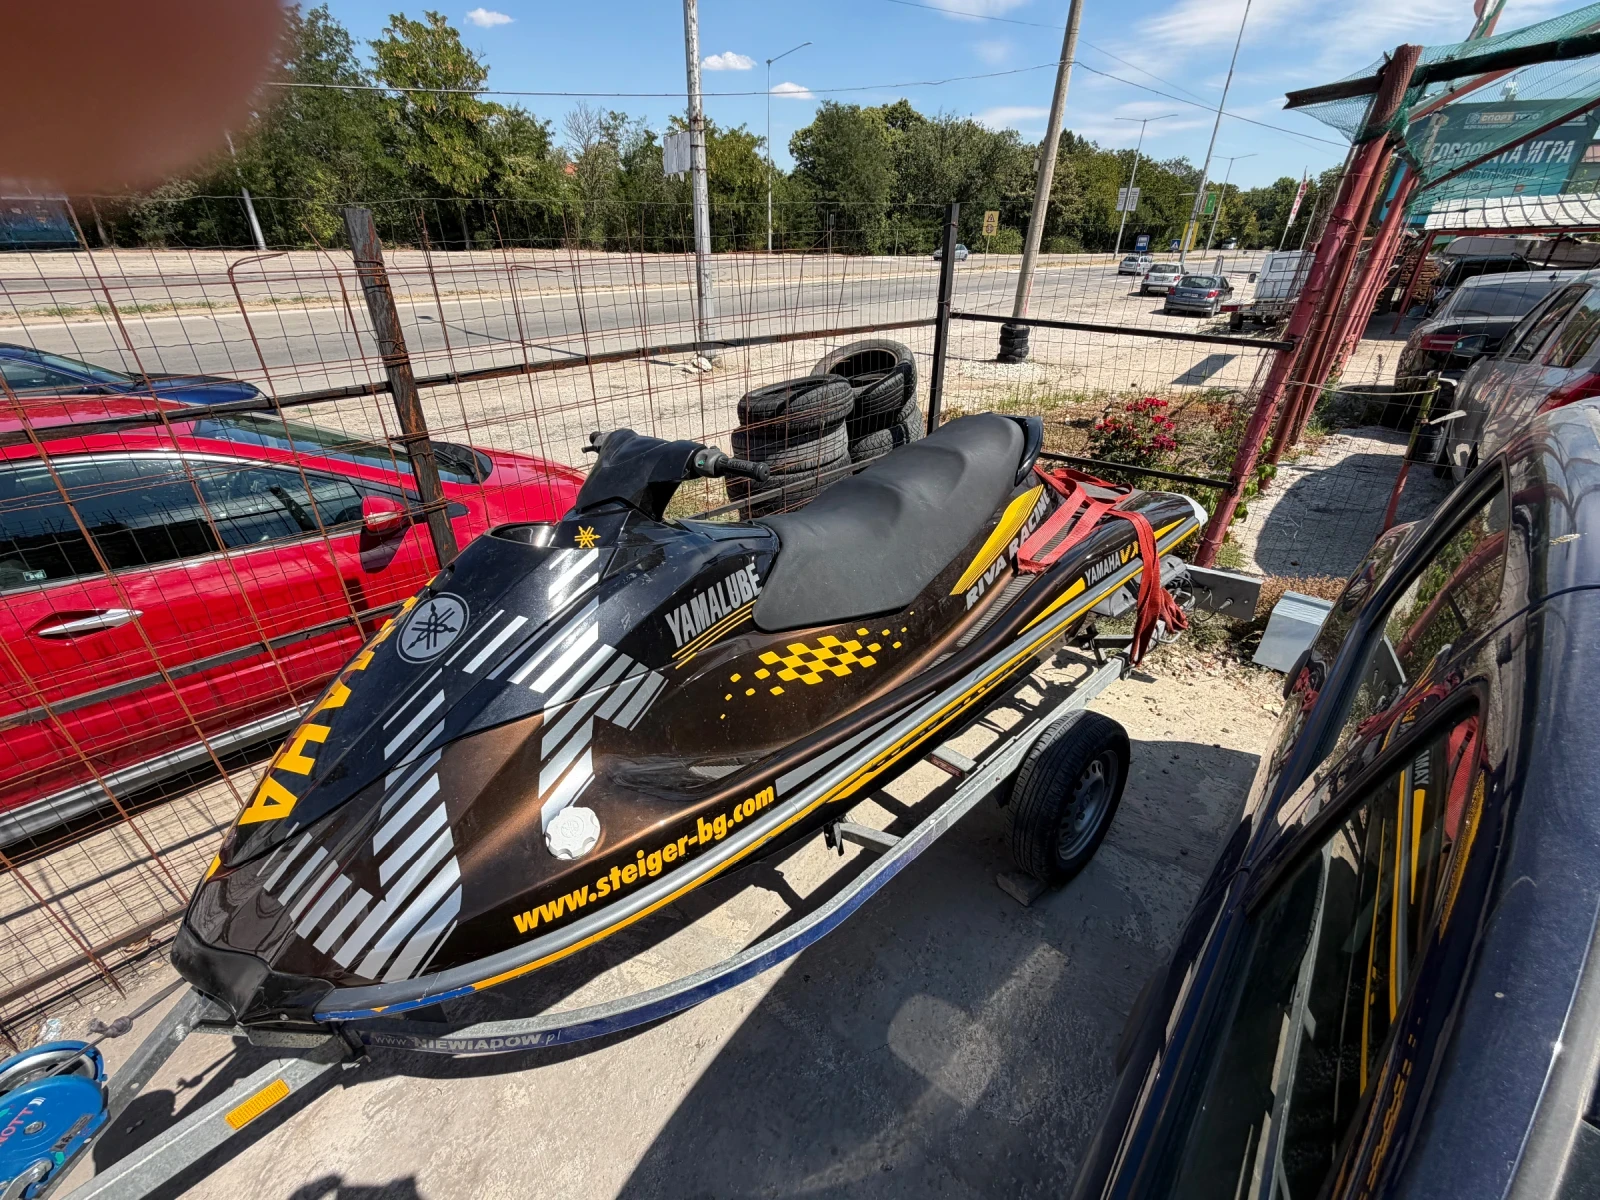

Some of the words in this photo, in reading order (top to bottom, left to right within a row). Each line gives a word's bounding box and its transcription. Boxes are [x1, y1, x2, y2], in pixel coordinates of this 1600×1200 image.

[1481, 113, 1514, 122] СПОРТ
[1526, 140, 1576, 164] ИГРА
[966, 555, 1007, 611] RIVA
[1084, 551, 1121, 587] YAMAHA
[665, 562, 763, 649] YAMALUBE
[512, 785, 775, 934] www.steiger-bg.com
